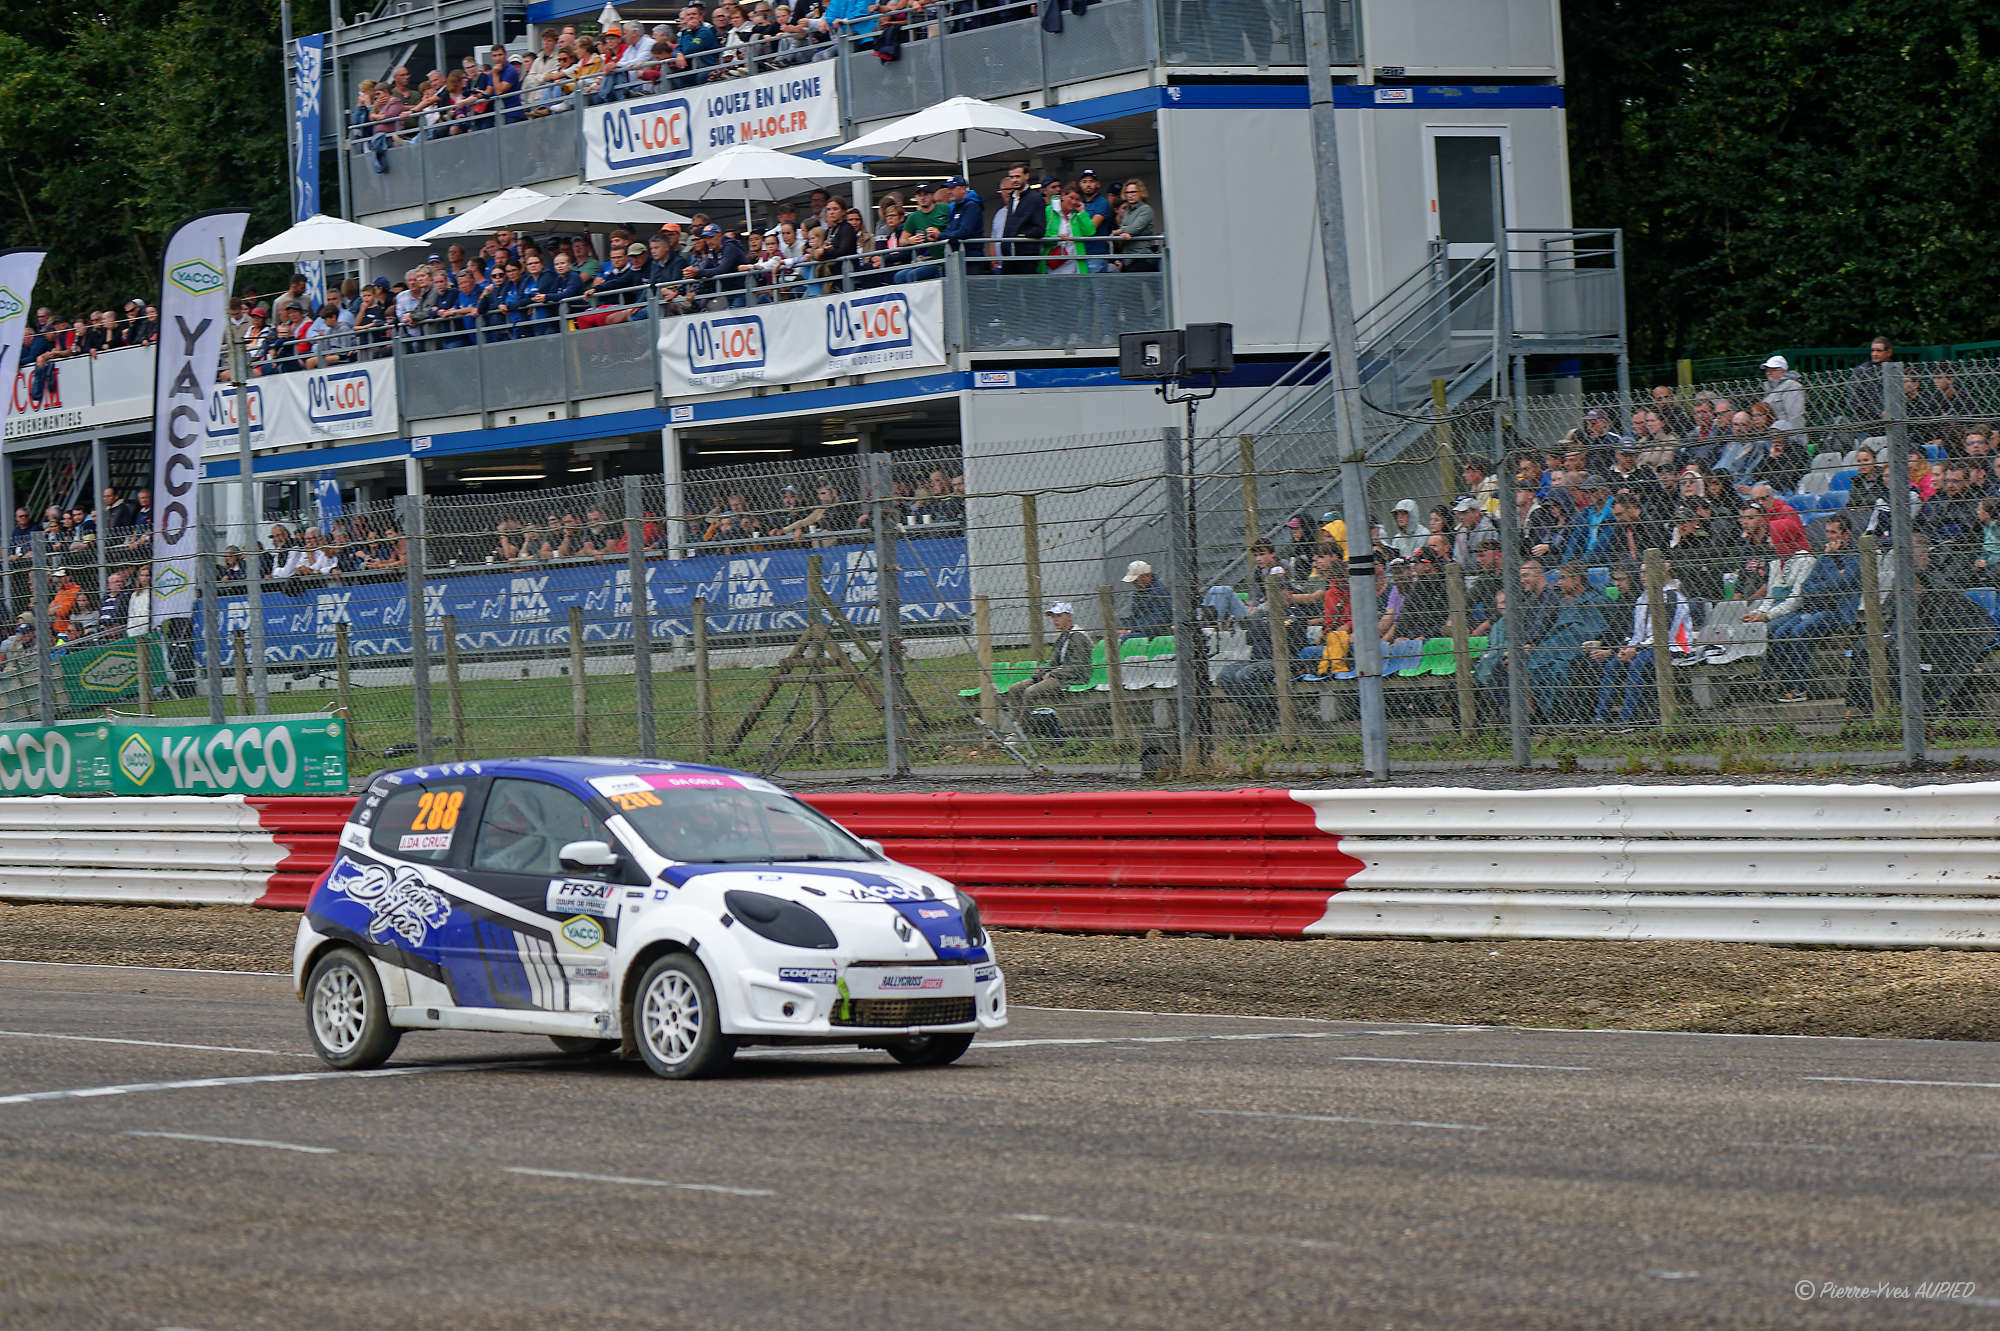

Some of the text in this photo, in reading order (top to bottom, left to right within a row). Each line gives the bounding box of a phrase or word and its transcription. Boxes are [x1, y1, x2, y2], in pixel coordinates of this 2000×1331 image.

[707, 76, 822, 118] LOUEZ EN LIGNE
[603, 108, 682, 153] M-LOC
[709, 110, 808, 148] SUR M-LOC.FR
[177, 271, 221, 284] YACCO
[826, 301, 903, 342] M-LOC
[687, 320, 757, 361] M-LOC
[308, 376, 365, 411] M-LOC
[162, 315, 213, 546] YACCO
[162, 725, 296, 789] YACCO
[411, 791, 464, 831] 288
[611, 791, 664, 811] 288
[421, 835, 449, 849] CRUZ
[559, 883, 606, 898] FFSA
[838, 885, 926, 901] YACCO
[566, 926, 600, 940] YACCO
[780, 968, 836, 978] COOPER
[881, 975, 923, 987] RALLYCROSS
